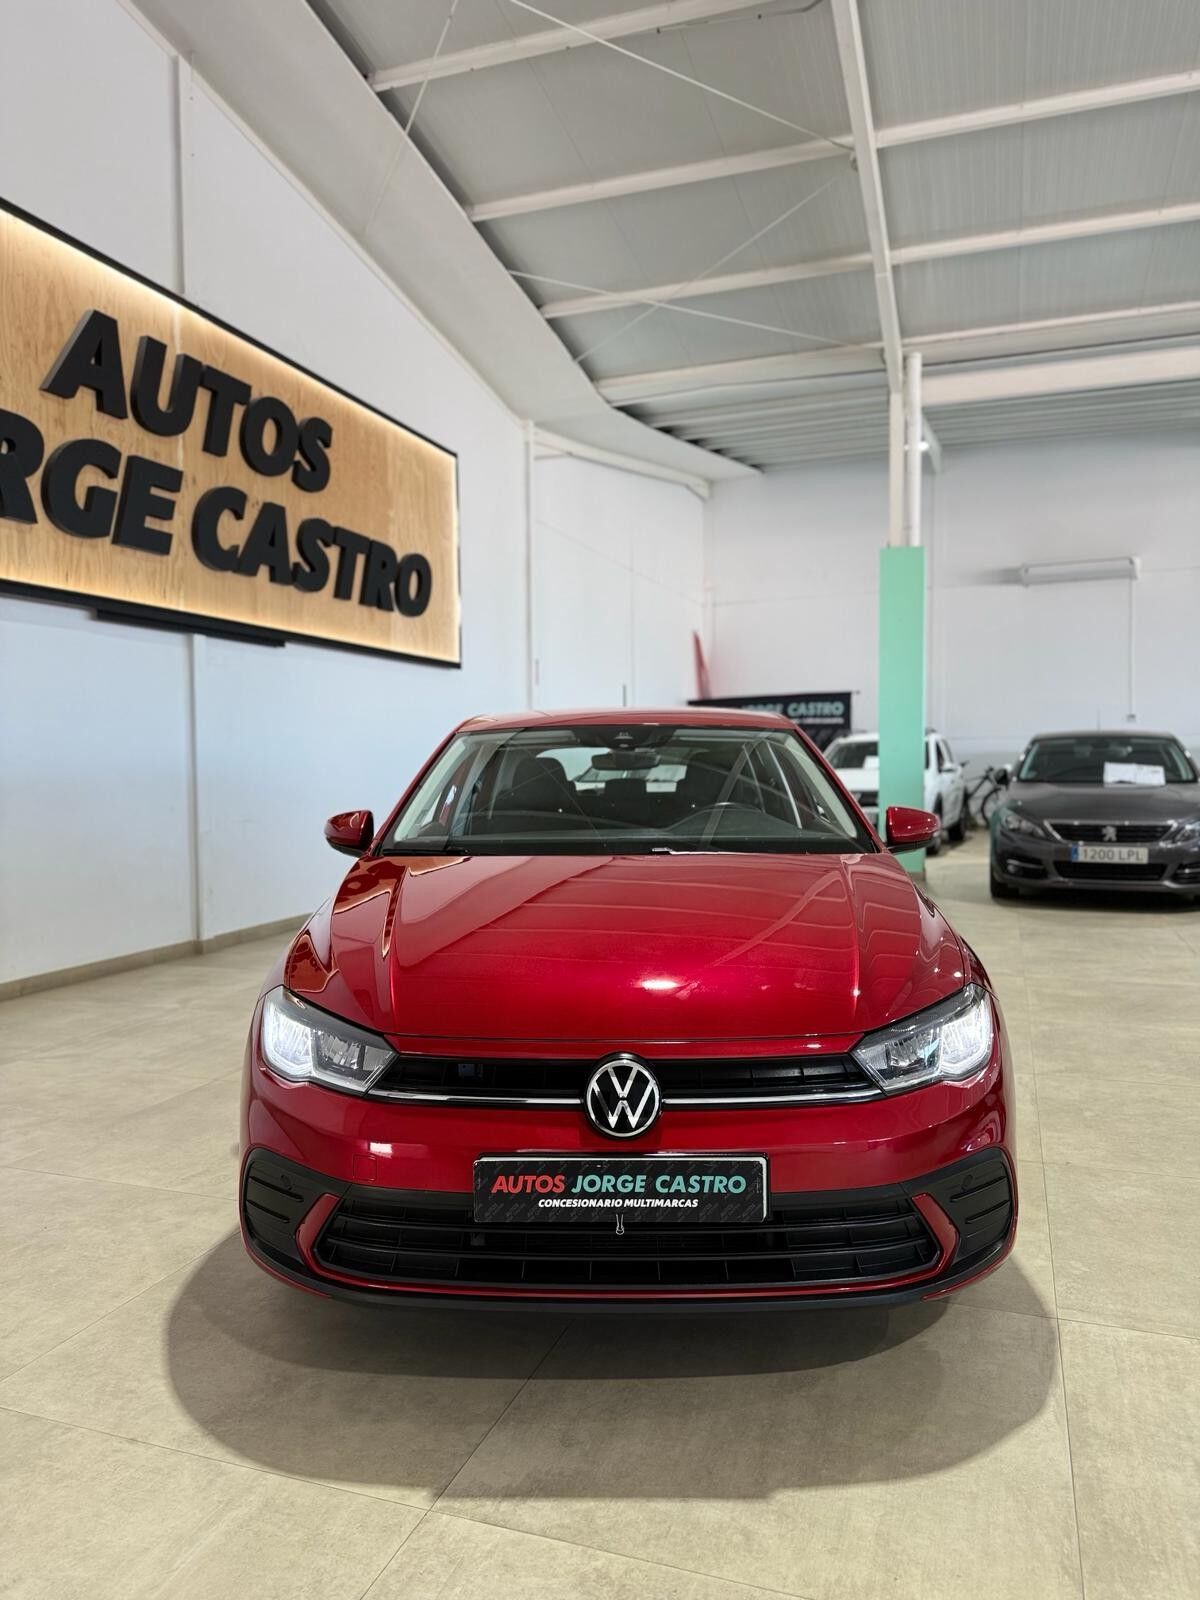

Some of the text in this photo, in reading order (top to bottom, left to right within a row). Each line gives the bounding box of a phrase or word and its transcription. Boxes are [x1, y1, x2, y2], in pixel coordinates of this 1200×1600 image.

[40, 309, 332, 492] AUTOS
[191, 486, 432, 617] CASTRO
[787, 701, 844, 717] CASTRO
[1082, 848, 1143, 862] 1200 LPL
[491, 1175, 747, 1194] AUTOS JORGE CASTRO
[538, 1198, 699, 1208] CONCESIONARIO MULTIMARCAS
